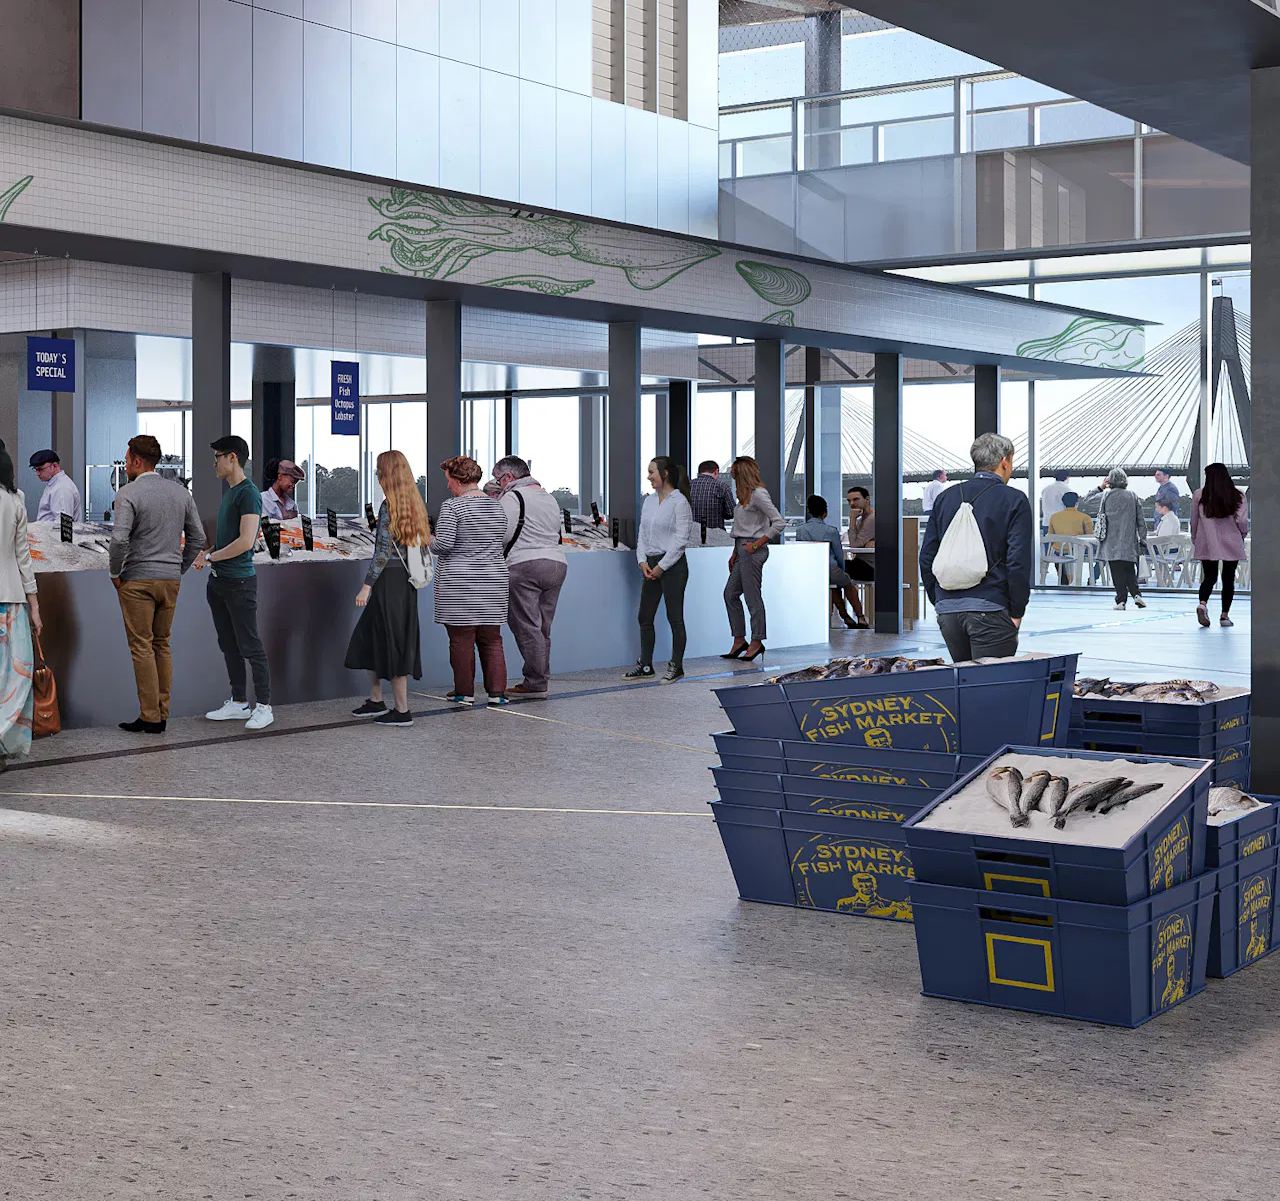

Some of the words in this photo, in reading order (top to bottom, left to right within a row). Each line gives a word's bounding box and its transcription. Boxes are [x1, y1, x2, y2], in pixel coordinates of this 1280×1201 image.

[36, 366, 66, 378] SPECIAL
[337, 374, 352, 384] FRESH
[339, 386, 351, 396] Fish
[334, 399, 354, 410] Octopus
[334, 411, 354, 420] Lobster
[821, 696, 912, 722] SYDNEY
[805, 720, 852, 743] FISH
[855, 712, 946, 730] MARKET
[816, 844, 904, 862] SYDNEY
[1154, 821, 1182, 866] SYDNEY
[1243, 834, 1267, 857] SYDNEY
[798, 861, 842, 875] FISH
[847, 860, 916, 878] MARKE
[1150, 865, 1163, 891] FISH
[1163, 836, 1190, 868] MARKET
[1243, 880, 1266, 907] SYDNEY
[1250, 896, 1271, 914] MARKET
[1158, 918, 1185, 949] SYDNEY
[1152, 948, 1166, 975] FISH
[1166, 935, 1191, 954] MARKET
